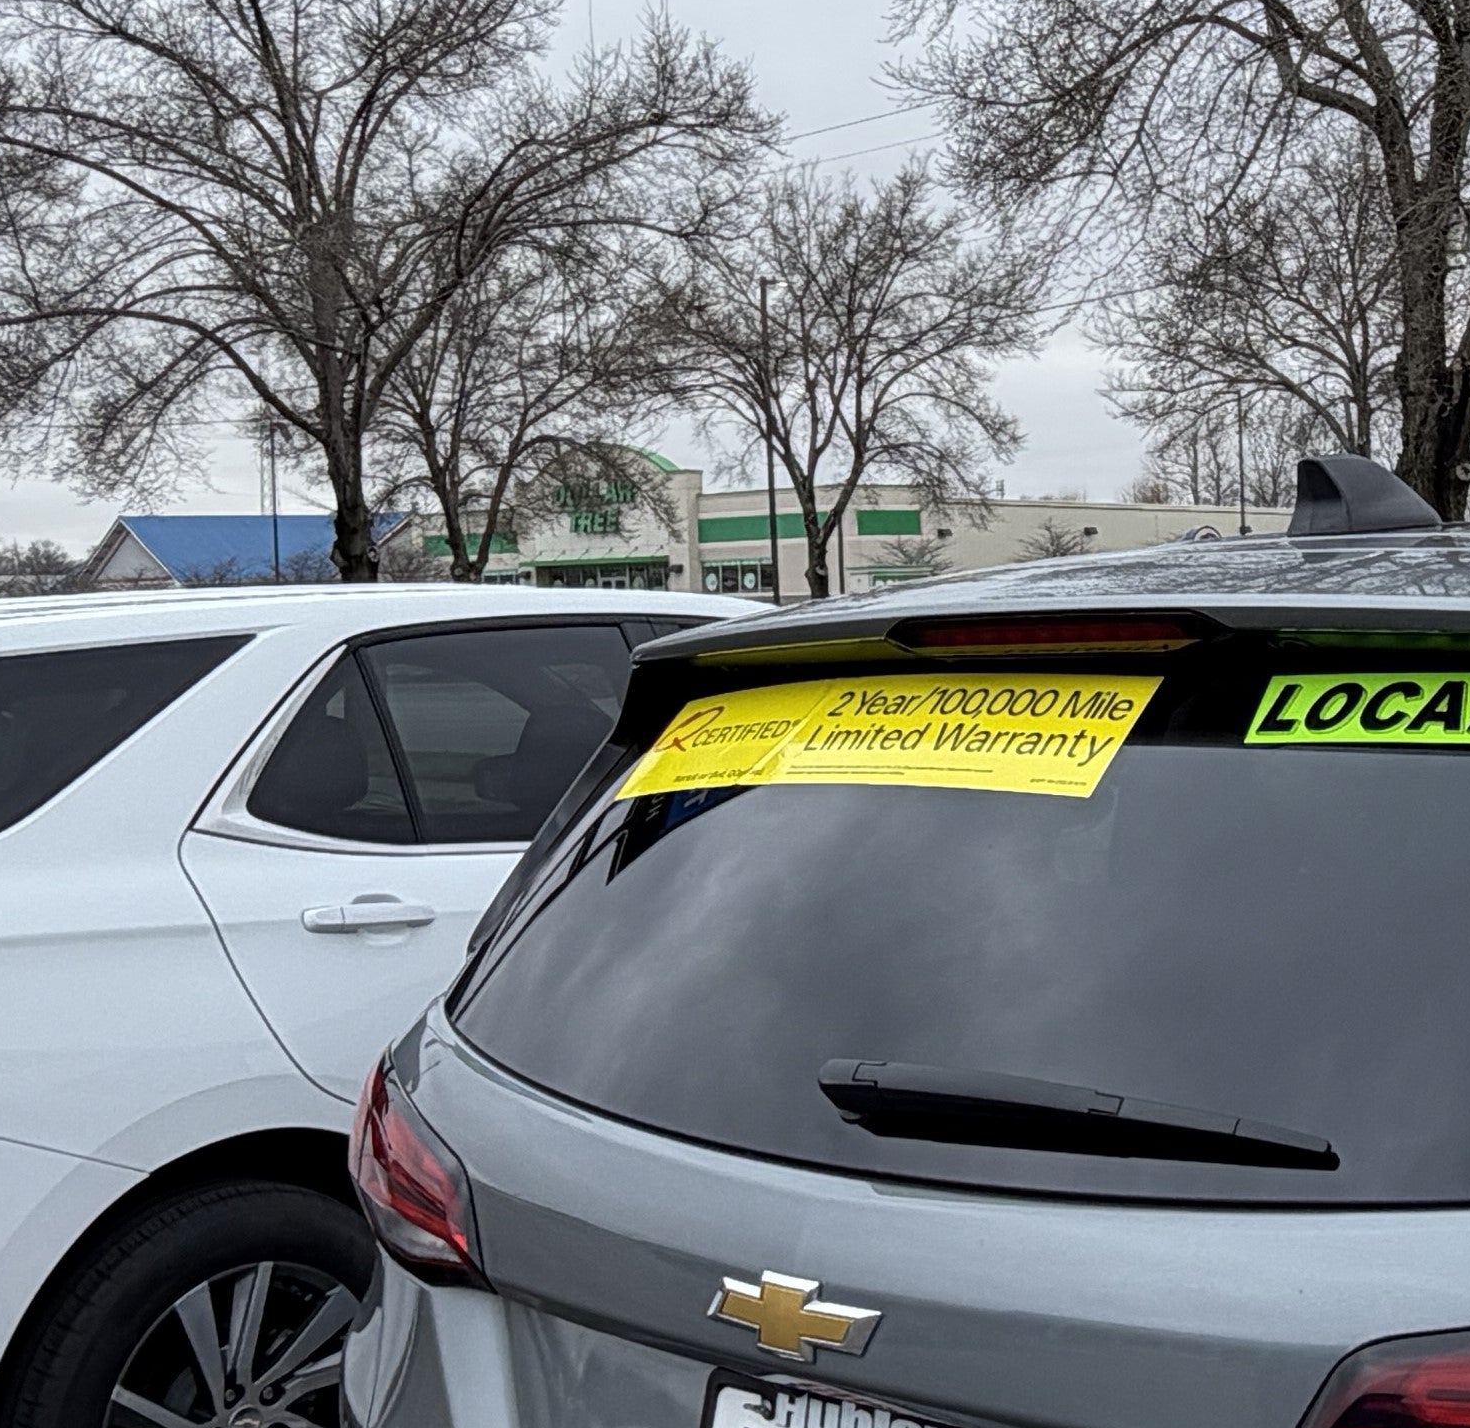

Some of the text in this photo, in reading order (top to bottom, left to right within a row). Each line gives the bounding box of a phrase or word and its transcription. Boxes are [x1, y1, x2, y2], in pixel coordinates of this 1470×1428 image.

[570, 510, 617, 532] TREE
[827, 688, 1135, 721] 2 Year/100,000 Mile
[803, 722, 1114, 767] Limited Warranty
